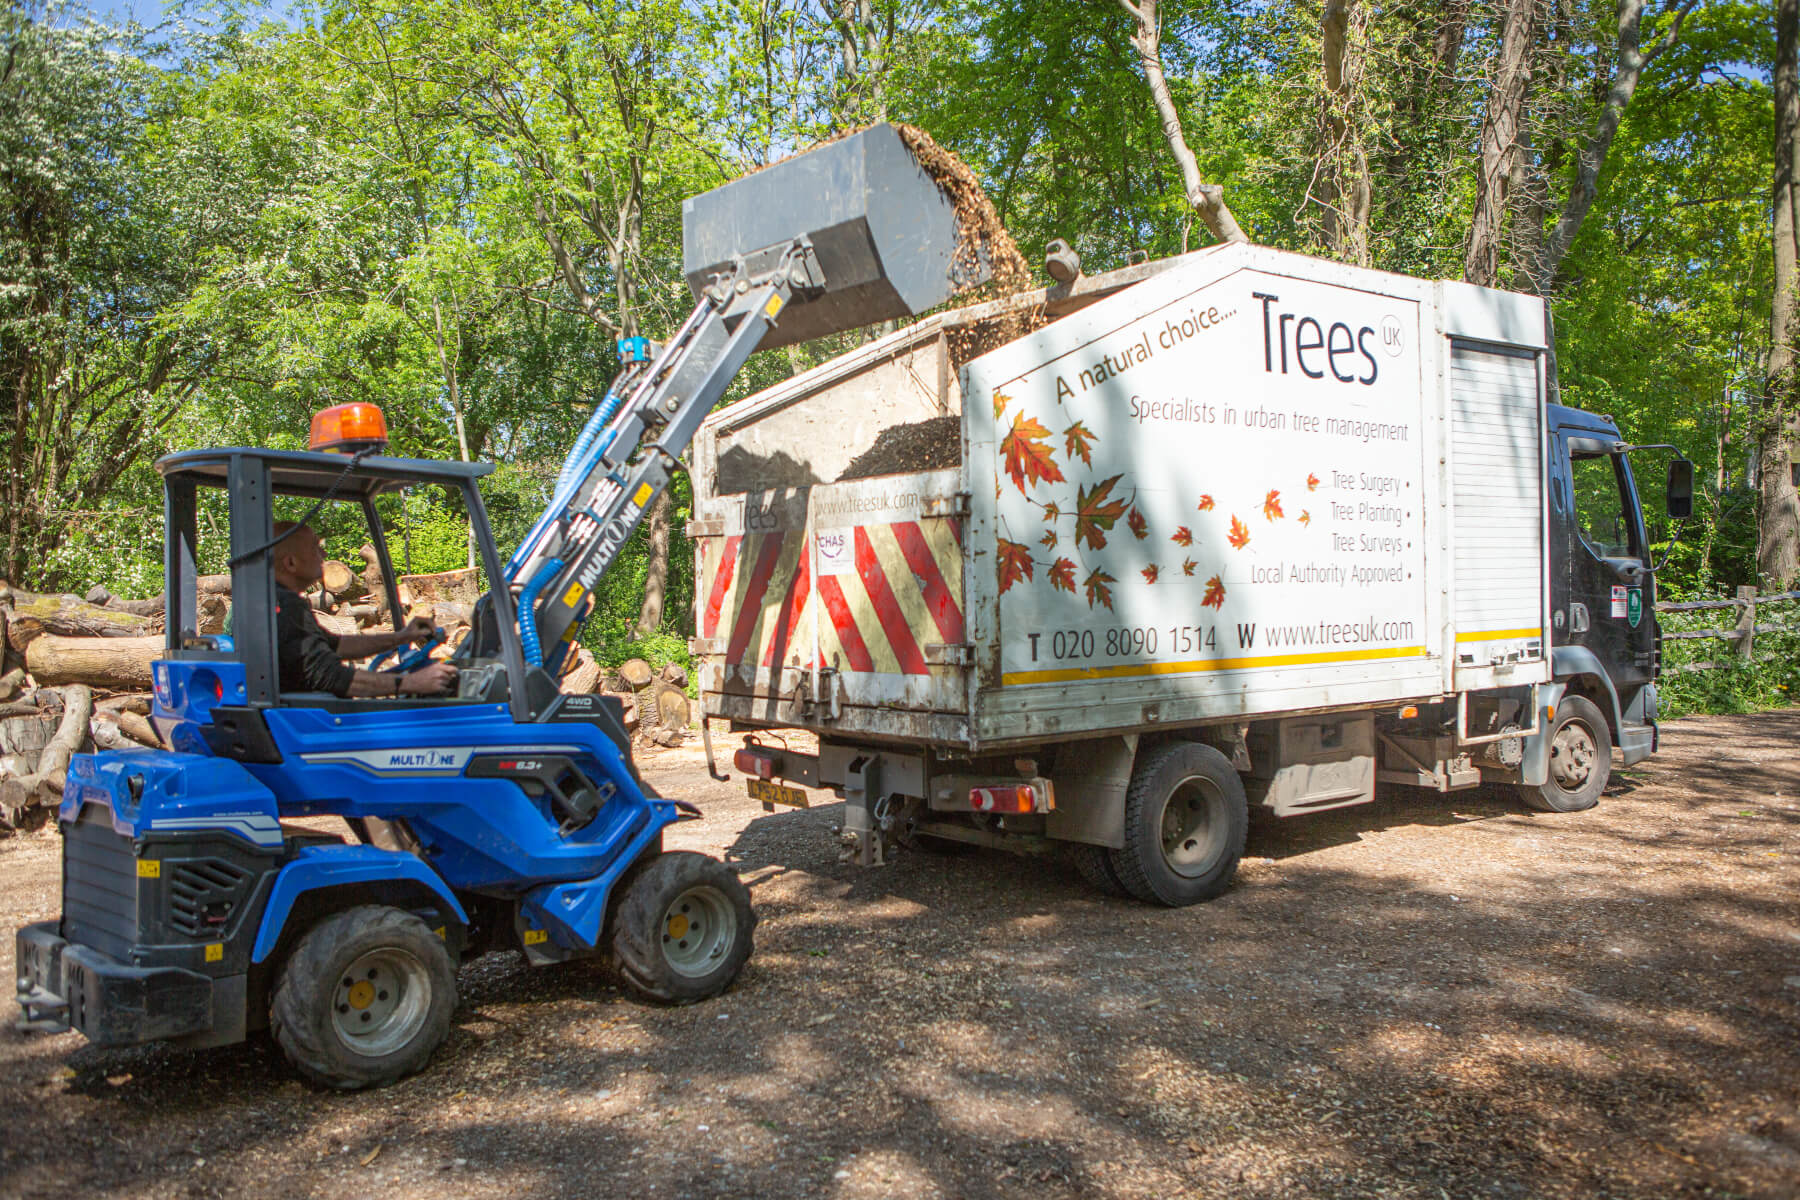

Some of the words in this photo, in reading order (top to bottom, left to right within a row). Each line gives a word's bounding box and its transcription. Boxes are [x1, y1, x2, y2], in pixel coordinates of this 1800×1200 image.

[1252, 291, 1378, 386] Trees
[1383, 326, 1402, 347] UK
[1056, 375, 1075, 405] A
[1078, 332, 1153, 391] natural
[1130, 395, 1216, 425] Specialists
[1223, 402, 1236, 425] in
[1244, 404, 1286, 430] urban
[1293, 411, 1320, 433] tree
[1326, 416, 1408, 443] management
[1331, 470, 1355, 490] Tree
[1359, 472, 1401, 497] Surgery
[1330, 501, 1354, 520] Tree
[1359, 501, 1402, 527] Planting
[818, 534, 845, 548] CHAS
[1331, 532, 1355, 551] Tree
[1359, 533, 1402, 557] Surveys
[1252, 561, 1283, 584] Local
[1289, 562, 1347, 588] Authority
[1351, 562, 1404, 588] Approved
[1028, 633, 1041, 662] T
[1053, 630, 1095, 659] 020
[1106, 627, 1157, 657] 8090
[1169, 625, 1217, 653] 1514
[1237, 623, 1256, 649] W
[1265, 616, 1413, 647] www.treesuk.com
